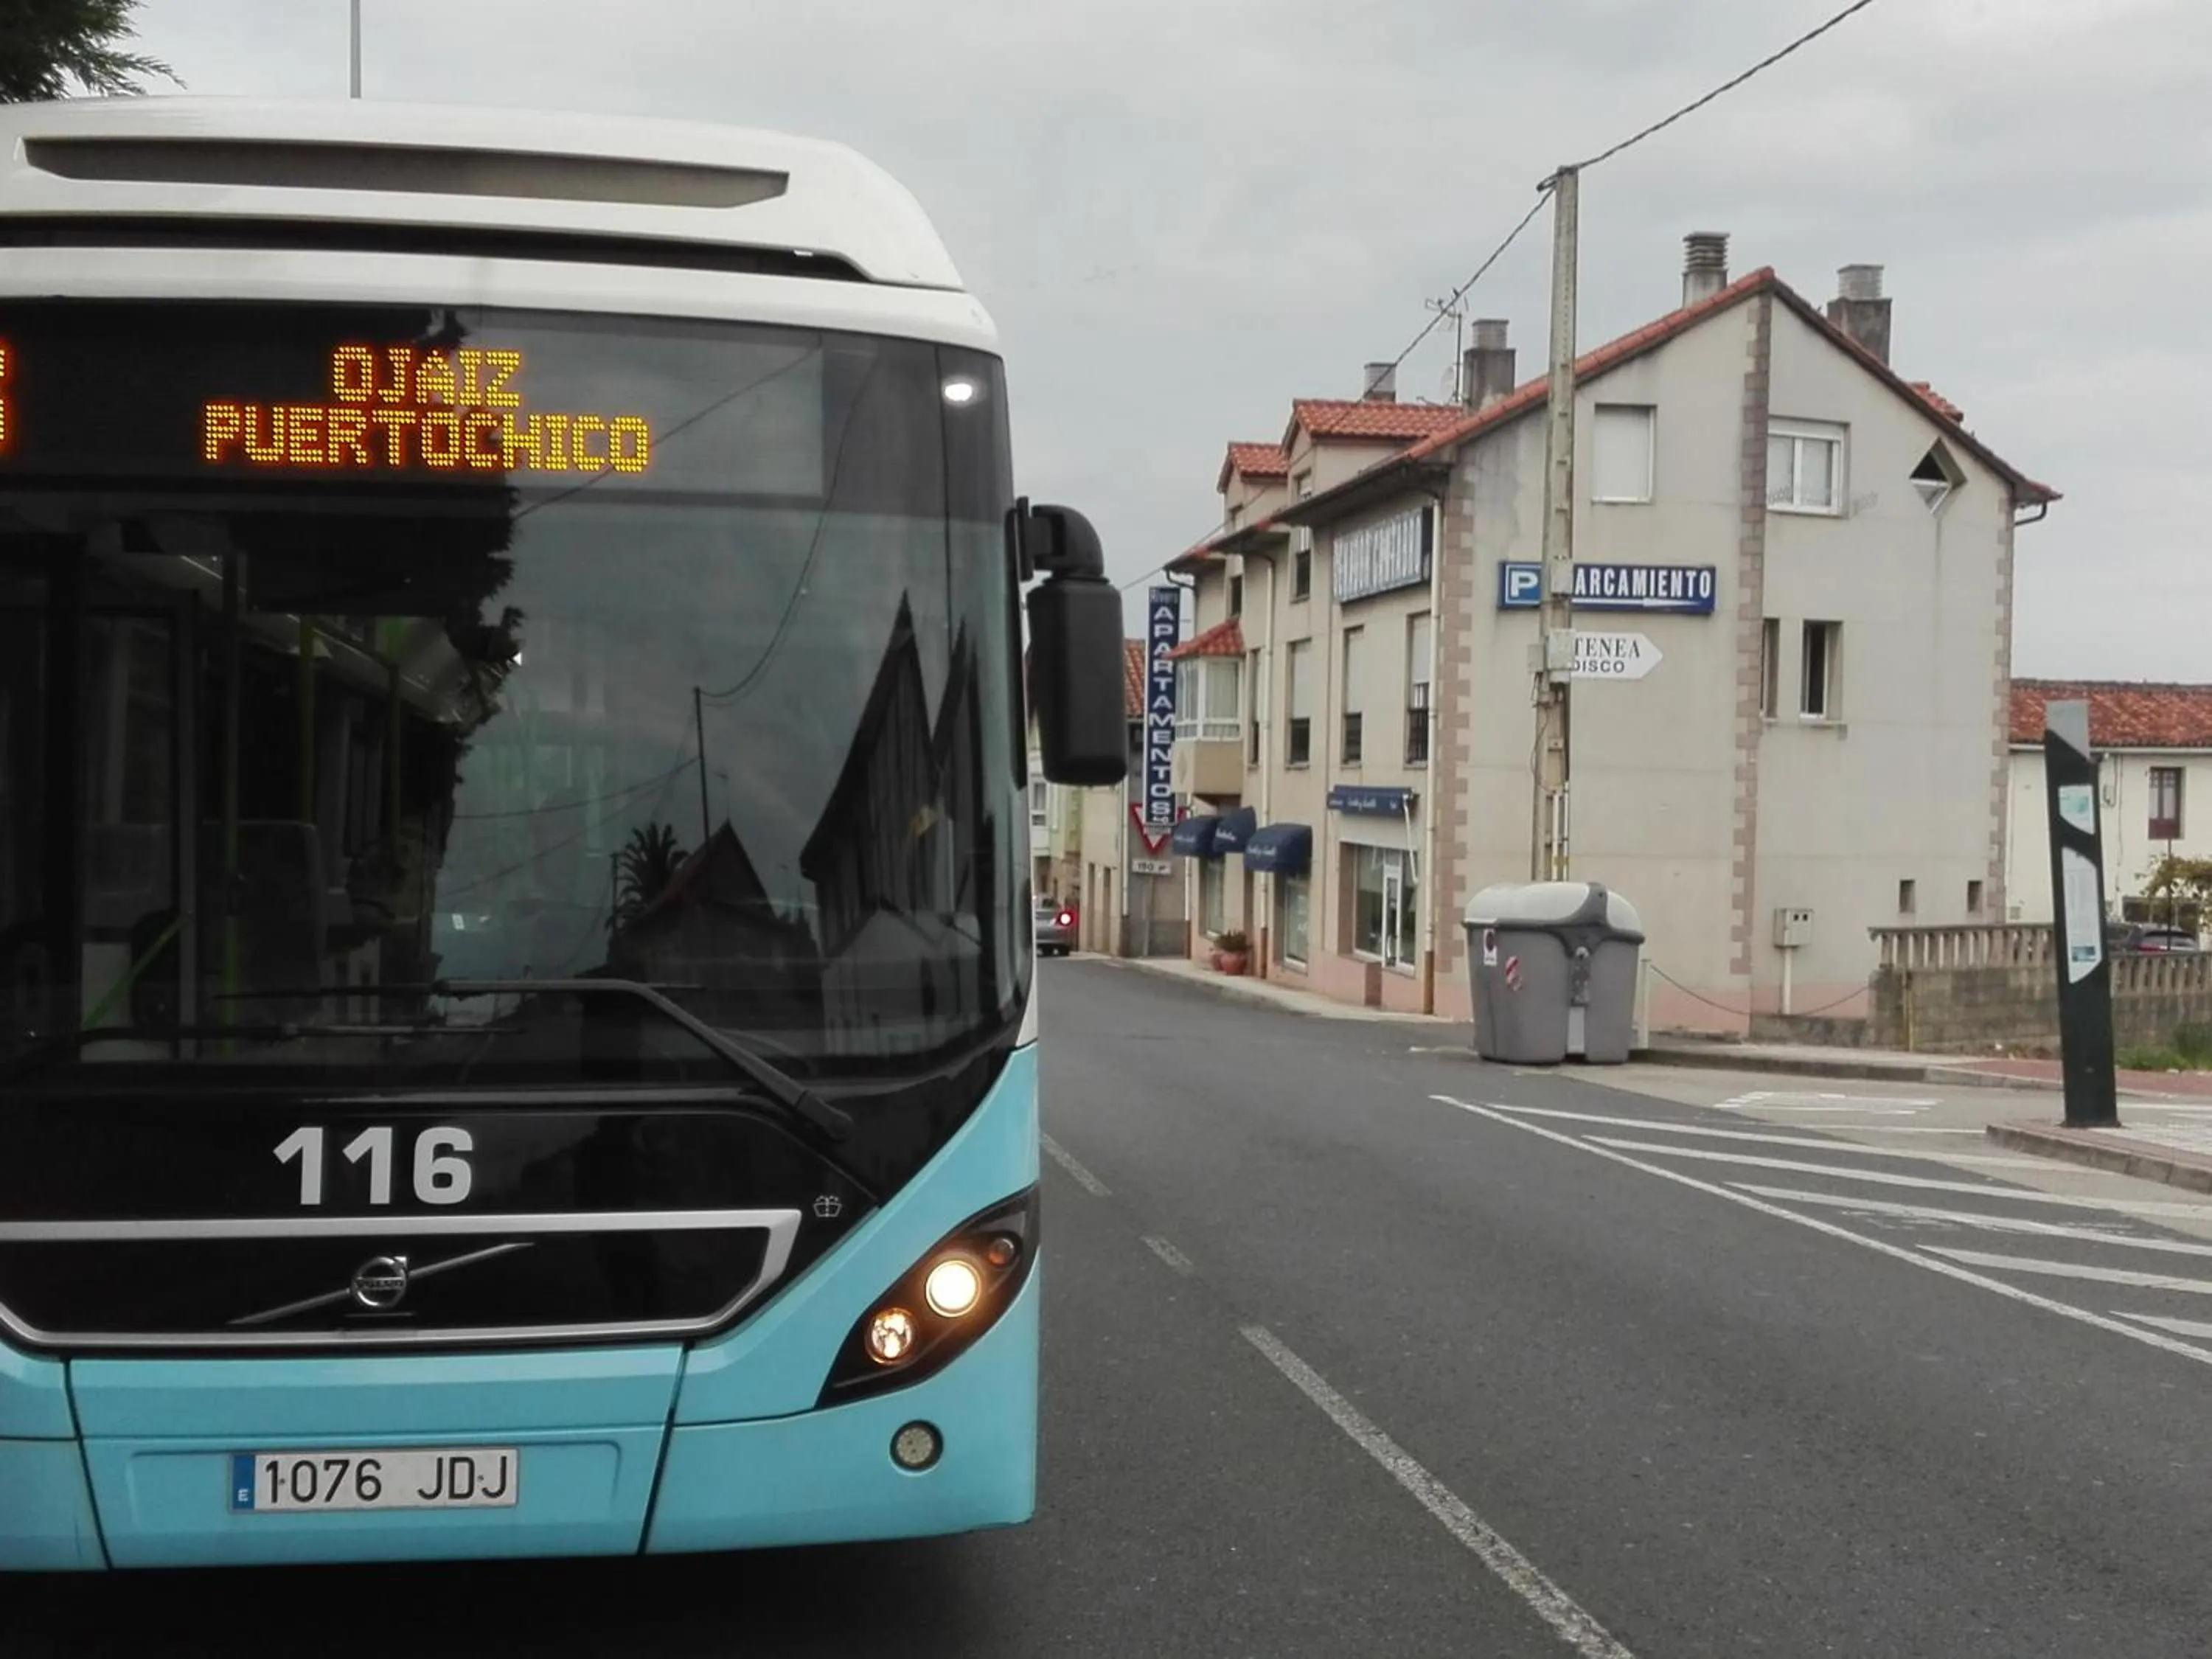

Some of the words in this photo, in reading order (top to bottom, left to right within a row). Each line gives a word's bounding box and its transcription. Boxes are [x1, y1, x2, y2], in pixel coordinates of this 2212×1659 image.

[332, 345, 521, 408] OJAIZ
[204, 403, 650, 473] PUERTOCHICO
[1511, 571, 1539, 598] P
[1574, 567, 1711, 599] ARCAMIENTO
[1574, 636, 1641, 659] TENEA
[1149, 605, 1175, 815] APARTAMENTOS
[274, 1126, 473, 1206] 116
[237, 1488, 248, 1502] E
[265, 1458, 382, 1503] 1076
[417, 1455, 507, 1500] JDJ
